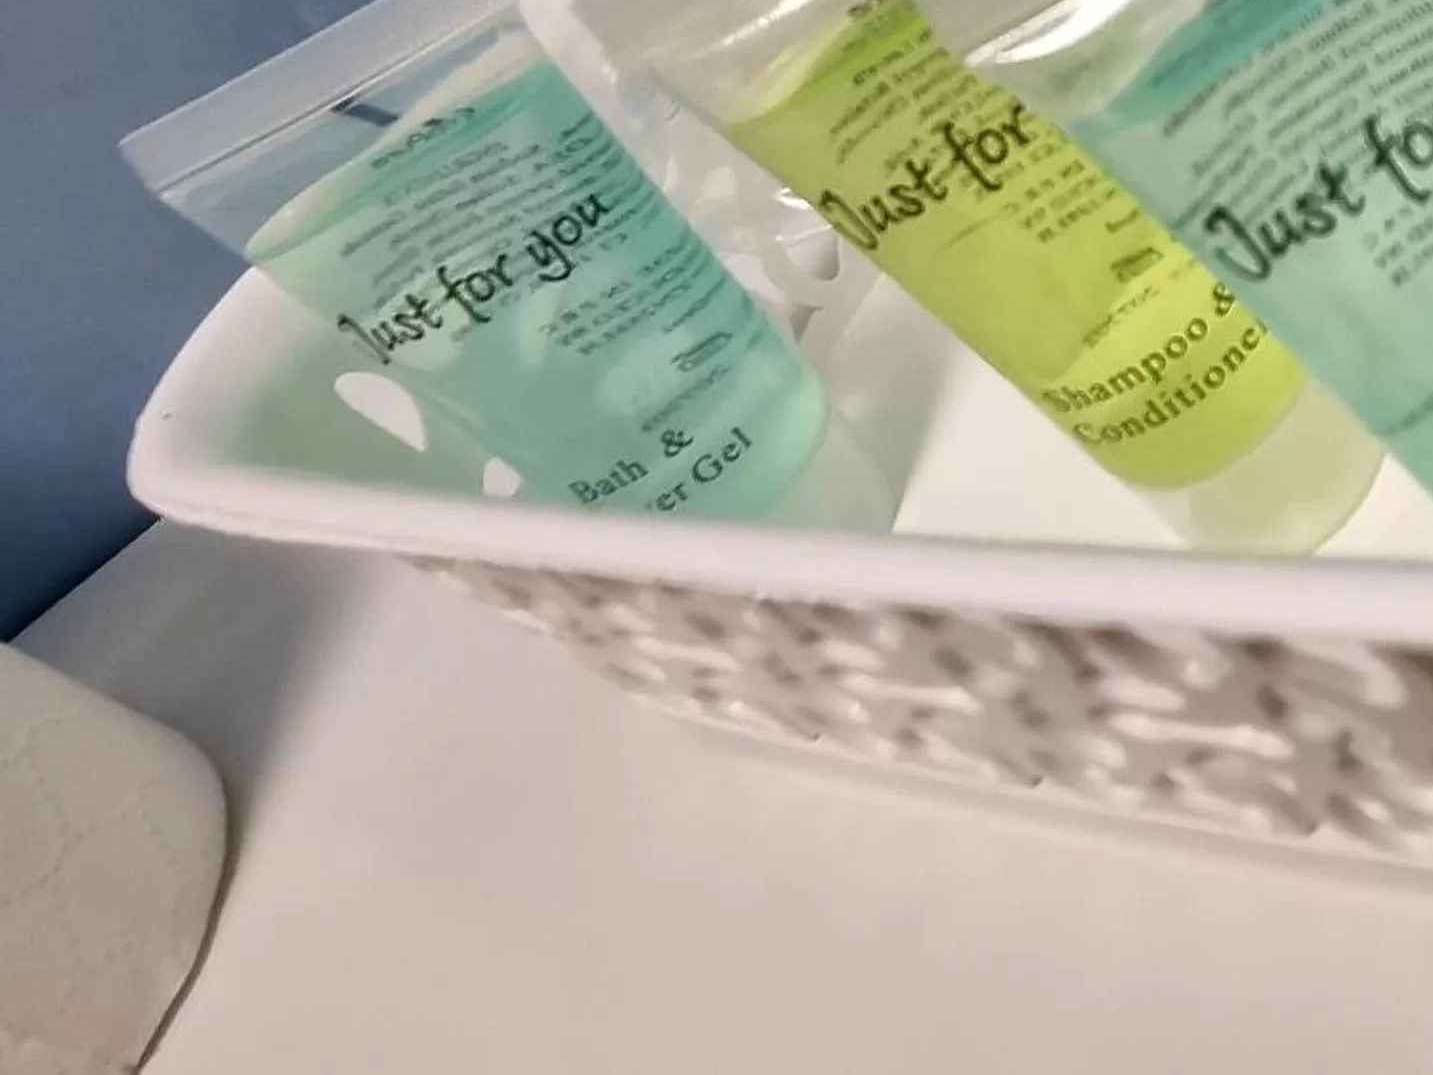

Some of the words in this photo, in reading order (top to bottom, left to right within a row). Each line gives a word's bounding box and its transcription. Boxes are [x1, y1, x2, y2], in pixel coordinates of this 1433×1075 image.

[818, 157, 949, 253] Just
[943, 103, 1032, 193] for
[1204, 158, 1366, 283] Just
[336, 293, 443, 365] Just
[435, 254, 517, 325] for
[526, 192, 613, 284] you
[1042, 316, 1209, 413] Shampoo
[568, 458, 649, 505] Bath
[659, 428, 694, 458] &
[691, 425, 753, 484] Gel
